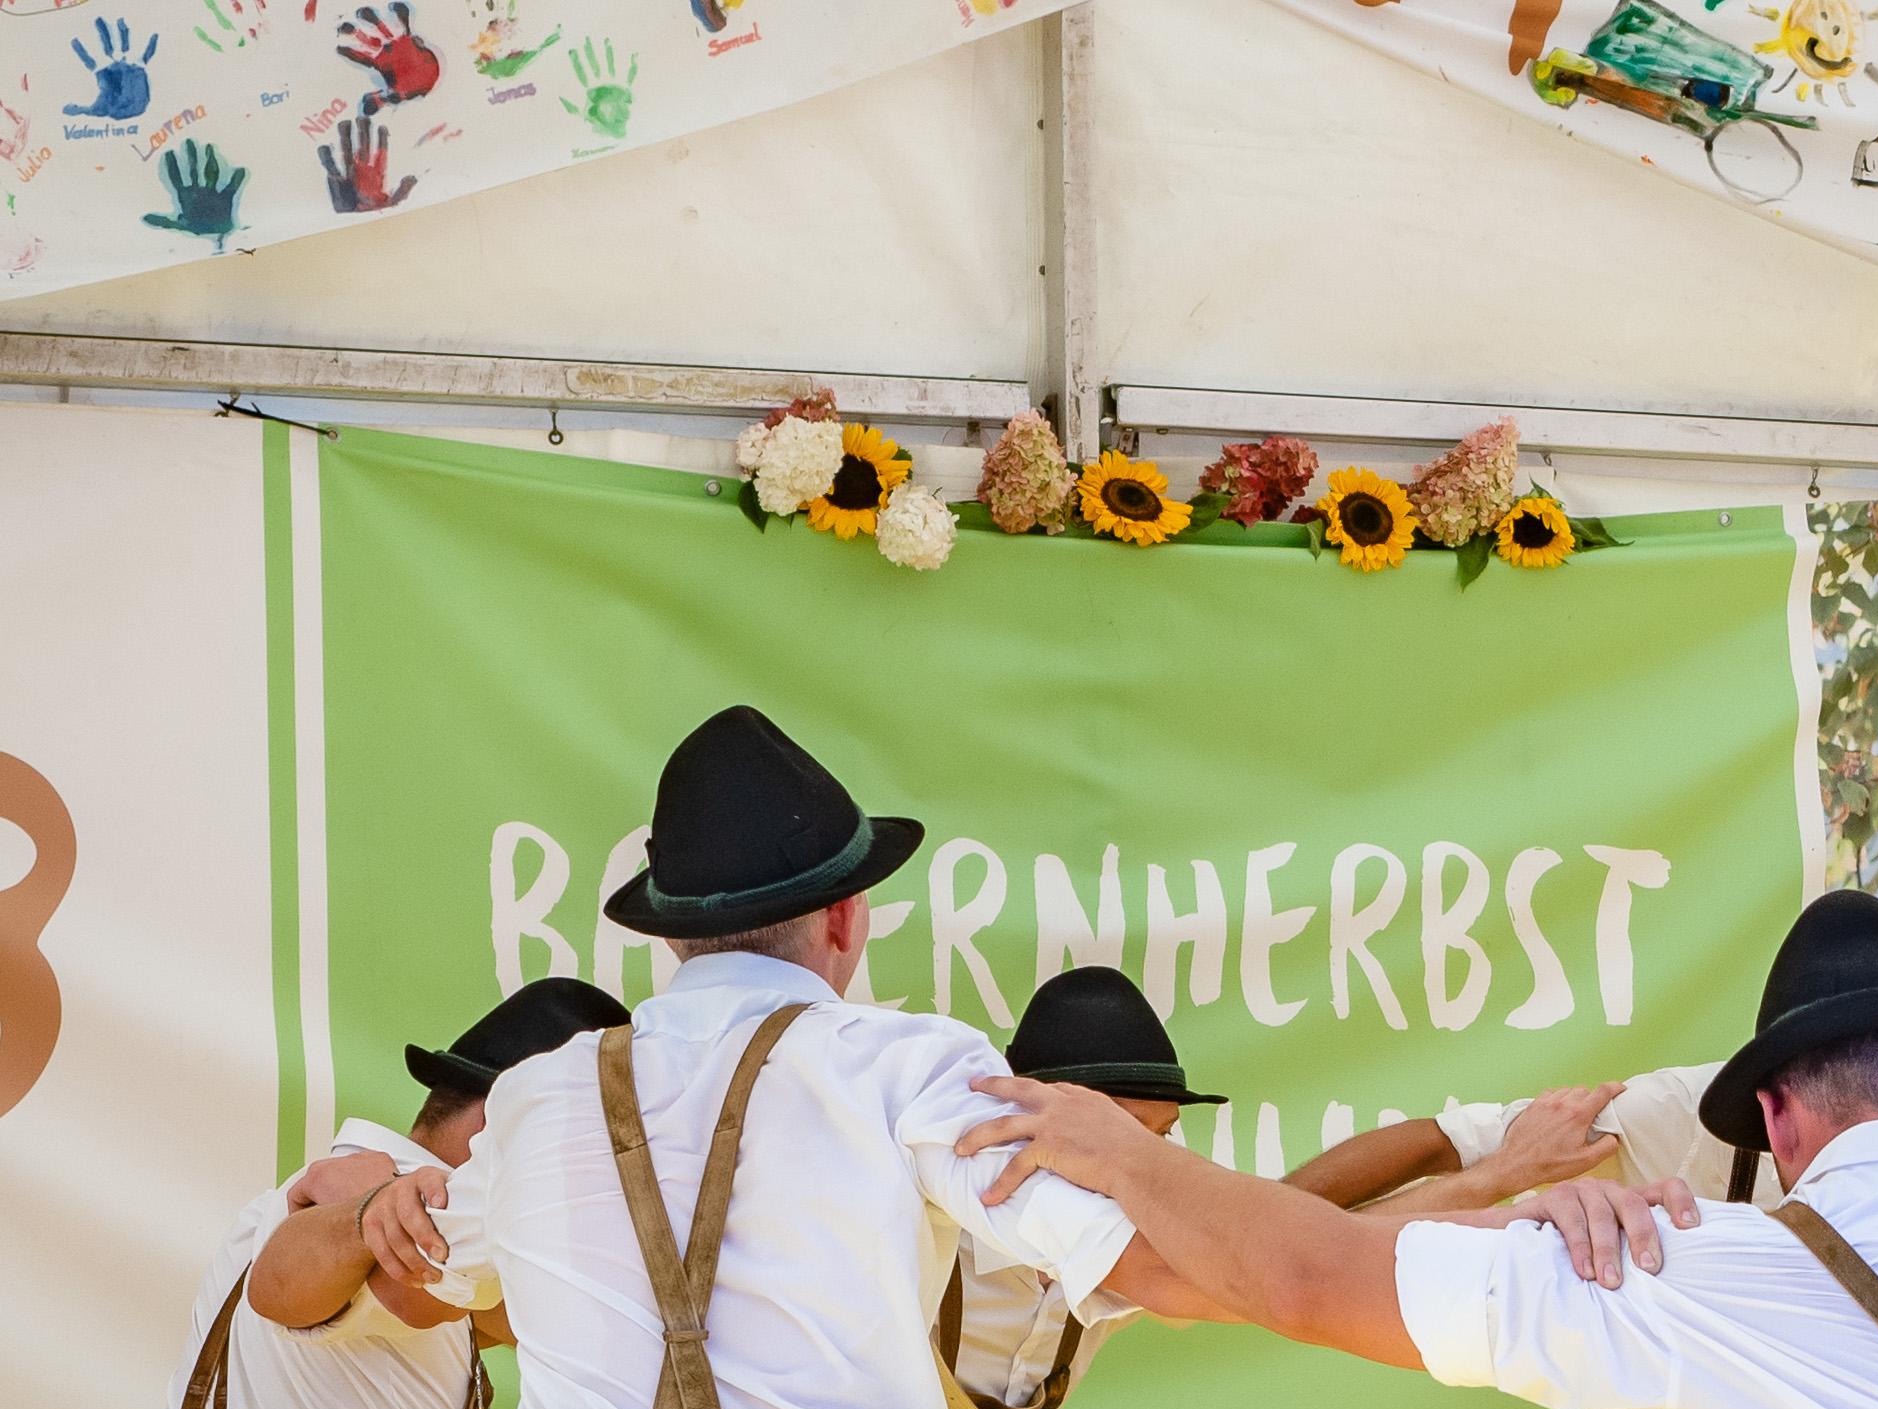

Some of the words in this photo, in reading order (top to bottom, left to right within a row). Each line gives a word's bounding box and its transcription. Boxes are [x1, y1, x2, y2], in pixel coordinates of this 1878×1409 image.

[707, 22, 763, 58] Samuel
[62, 123, 139, 141] Valentina
[131, 104, 208, 162] Laurena
[299, 97, 347, 142] Nina
[16, 145, 53, 184] Julia
